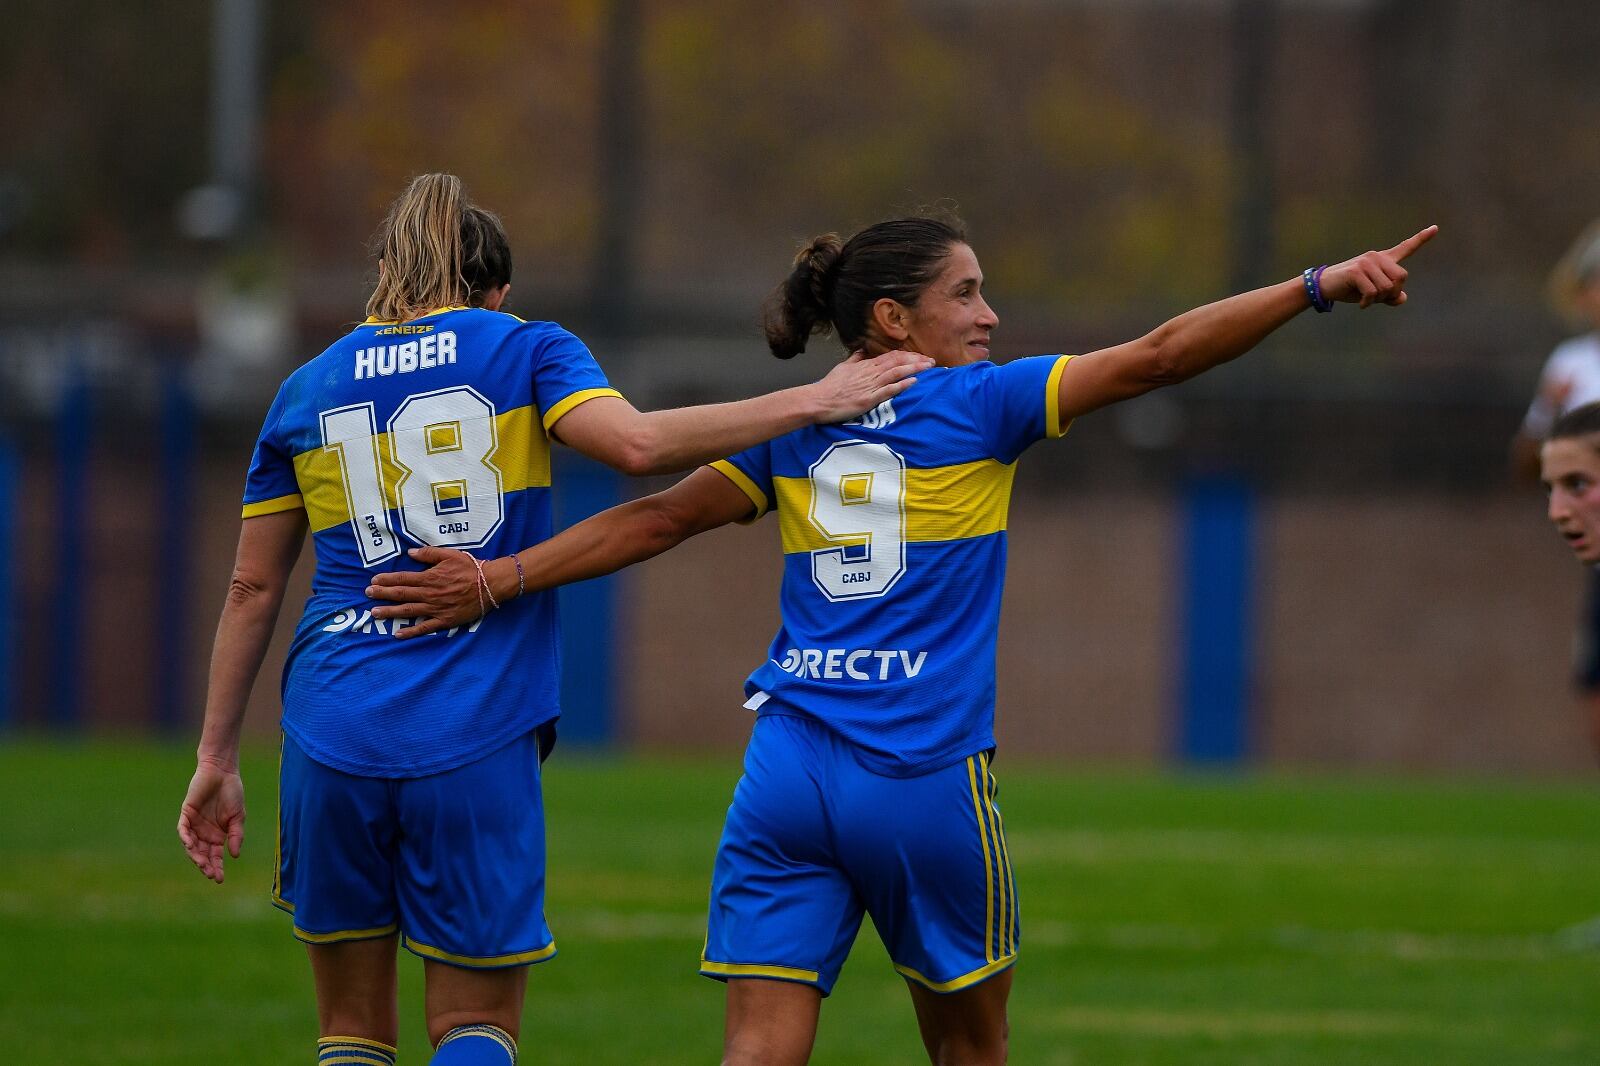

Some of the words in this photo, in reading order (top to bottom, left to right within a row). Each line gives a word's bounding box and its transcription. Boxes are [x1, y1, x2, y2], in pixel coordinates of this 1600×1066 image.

[374, 325, 435, 336] XENEIZE
[355, 331, 457, 380] HUBER
[319, 384, 504, 568] 18
[365, 514, 383, 547] CABJ
[438, 521, 469, 534] CABJ
[808, 438, 907, 602] 9
[842, 571, 871, 584] CABJ
